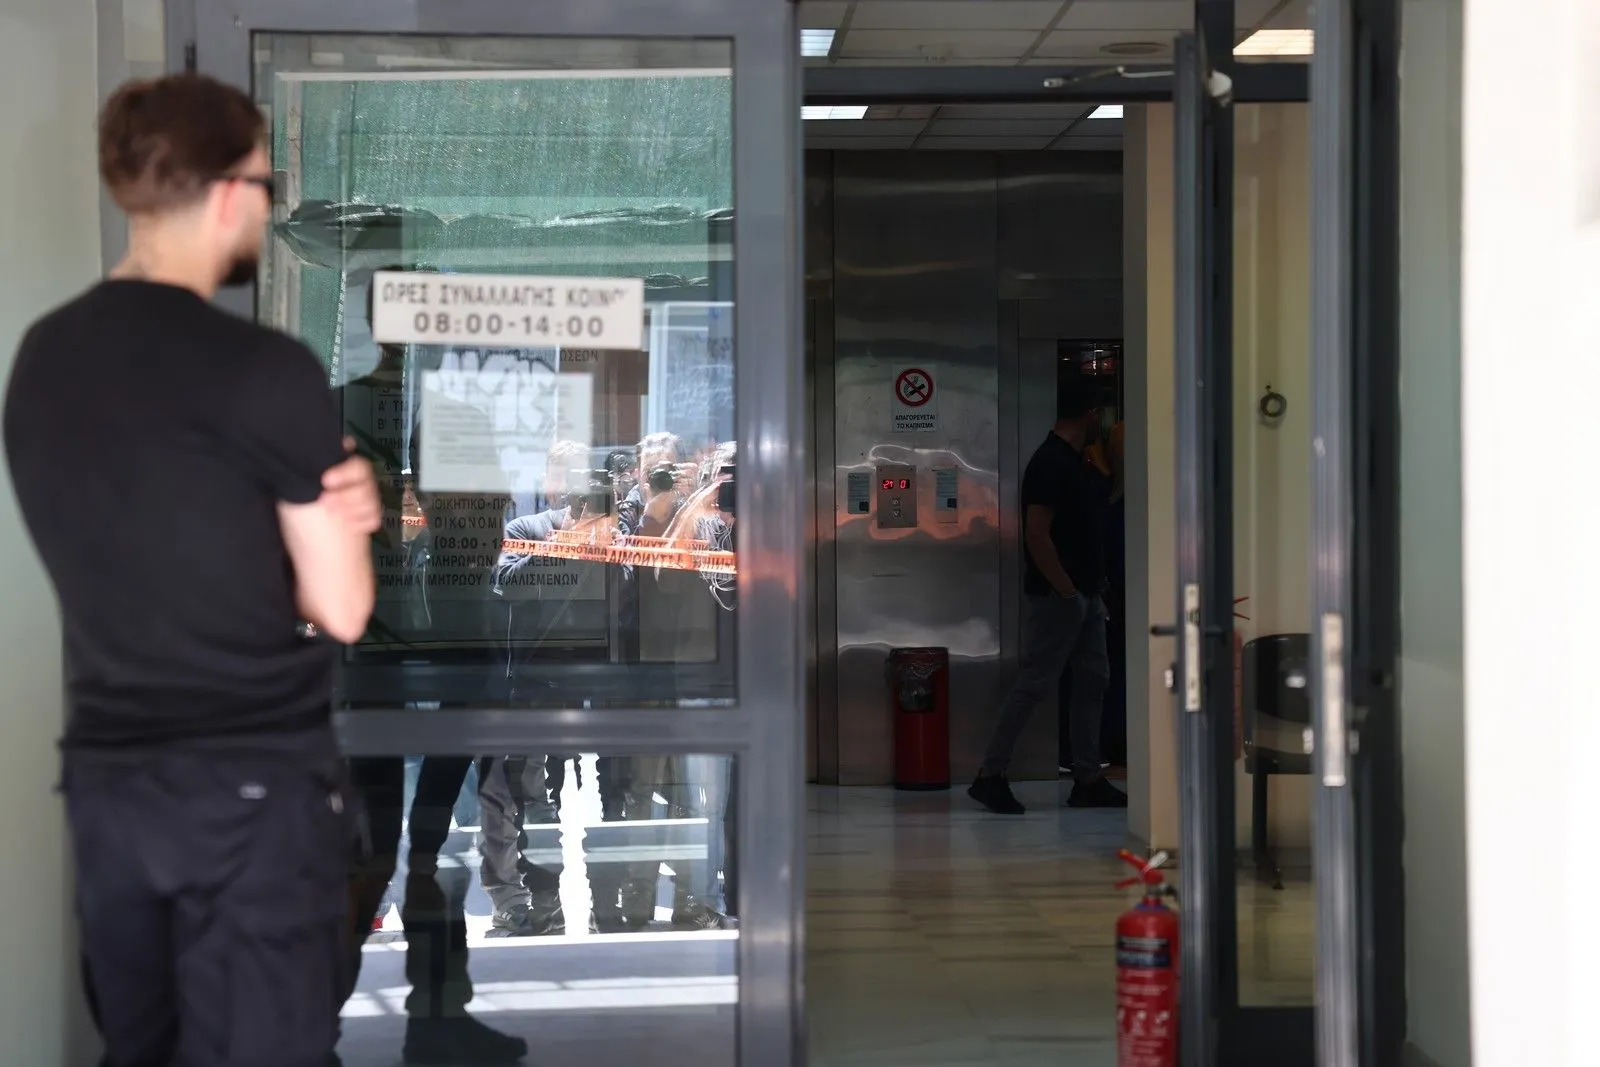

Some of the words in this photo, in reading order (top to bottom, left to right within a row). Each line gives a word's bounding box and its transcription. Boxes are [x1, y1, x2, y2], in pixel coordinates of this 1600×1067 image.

[382, 281, 429, 304] ΩΡΕΣ
[438, 282, 556, 308] ΣΥΝΑΛΛΑΓΗΣ
[565, 286, 627, 309] ΚΟΙΝΟ
[413, 312, 605, 338] 08:00-14:00
